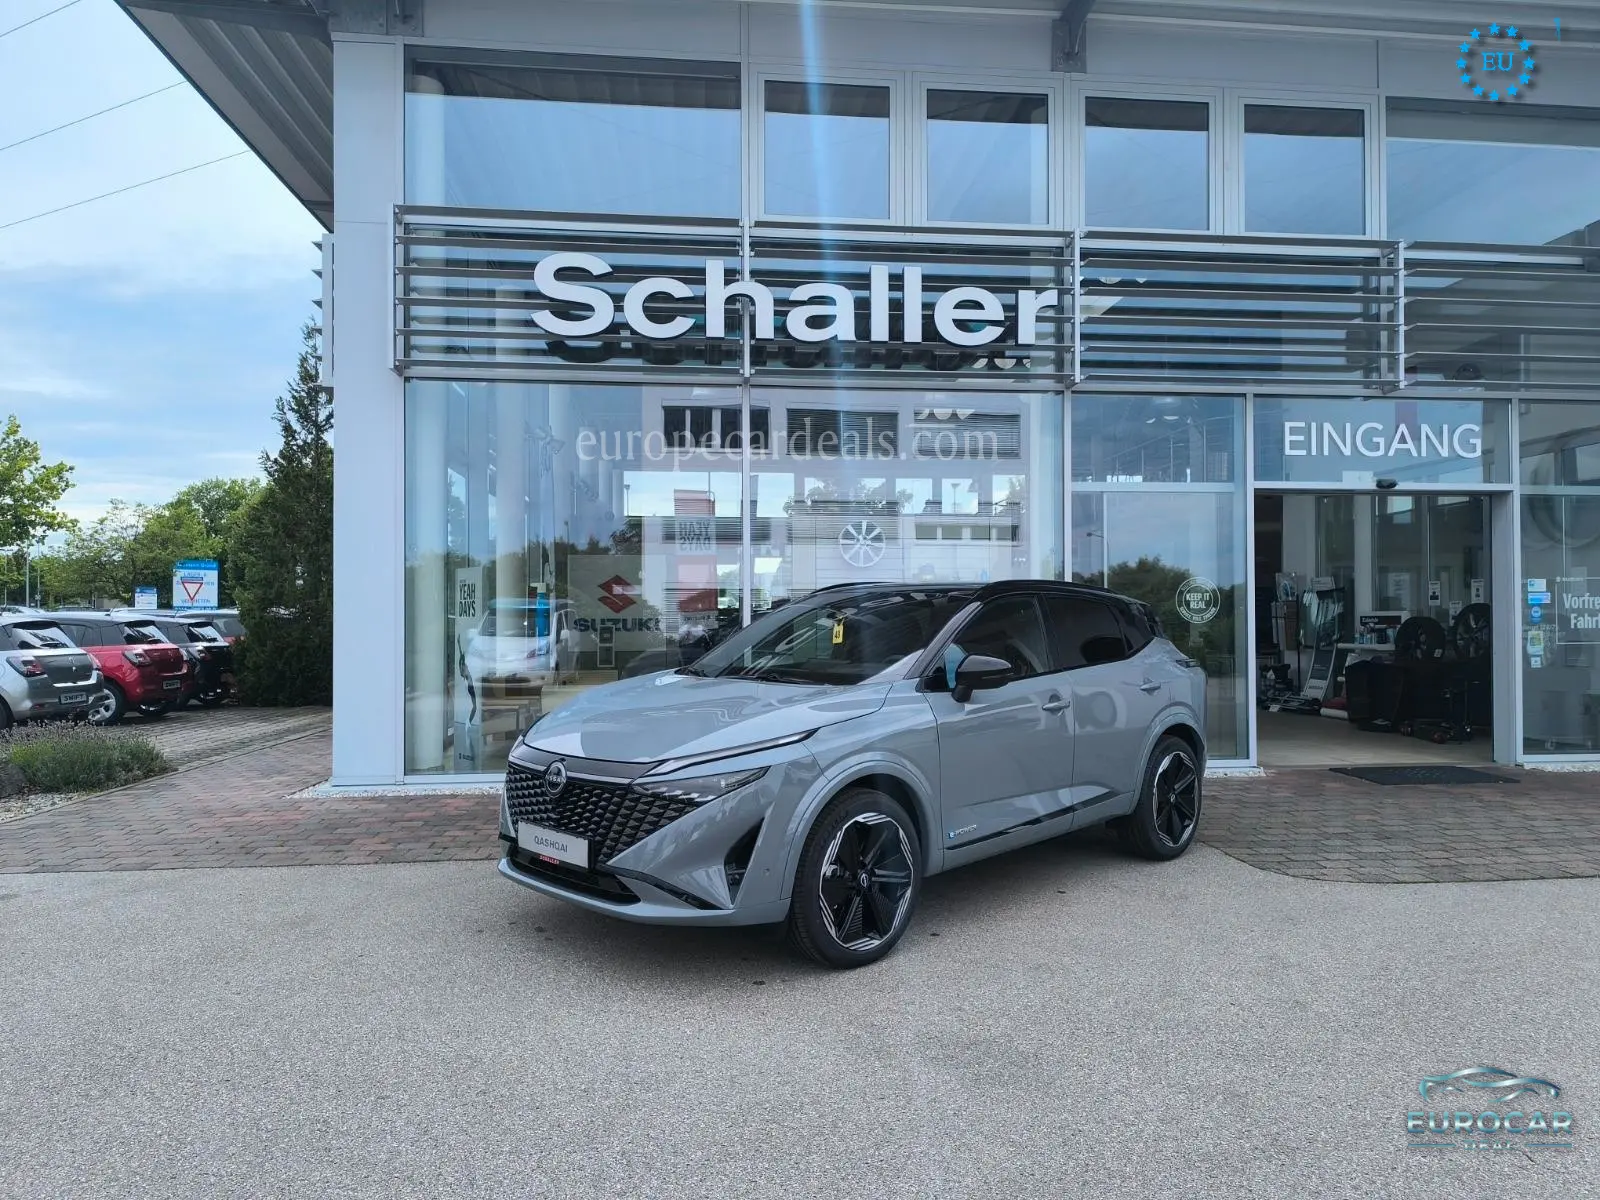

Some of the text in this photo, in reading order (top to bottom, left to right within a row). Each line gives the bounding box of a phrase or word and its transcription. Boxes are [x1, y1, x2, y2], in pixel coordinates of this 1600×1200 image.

[530, 250, 1058, 348] Schaller
[1283, 421, 1482, 459] EINGANG
[459, 583, 476, 600] YEAH
[1186, 592, 1210, 601] KEEP IT
[459, 600, 476, 617] DAYS
[1189, 601, 1207, 609] REAL
[573, 617, 661, 633] SUZUKI
[534, 835, 568, 853] QASHQAI
